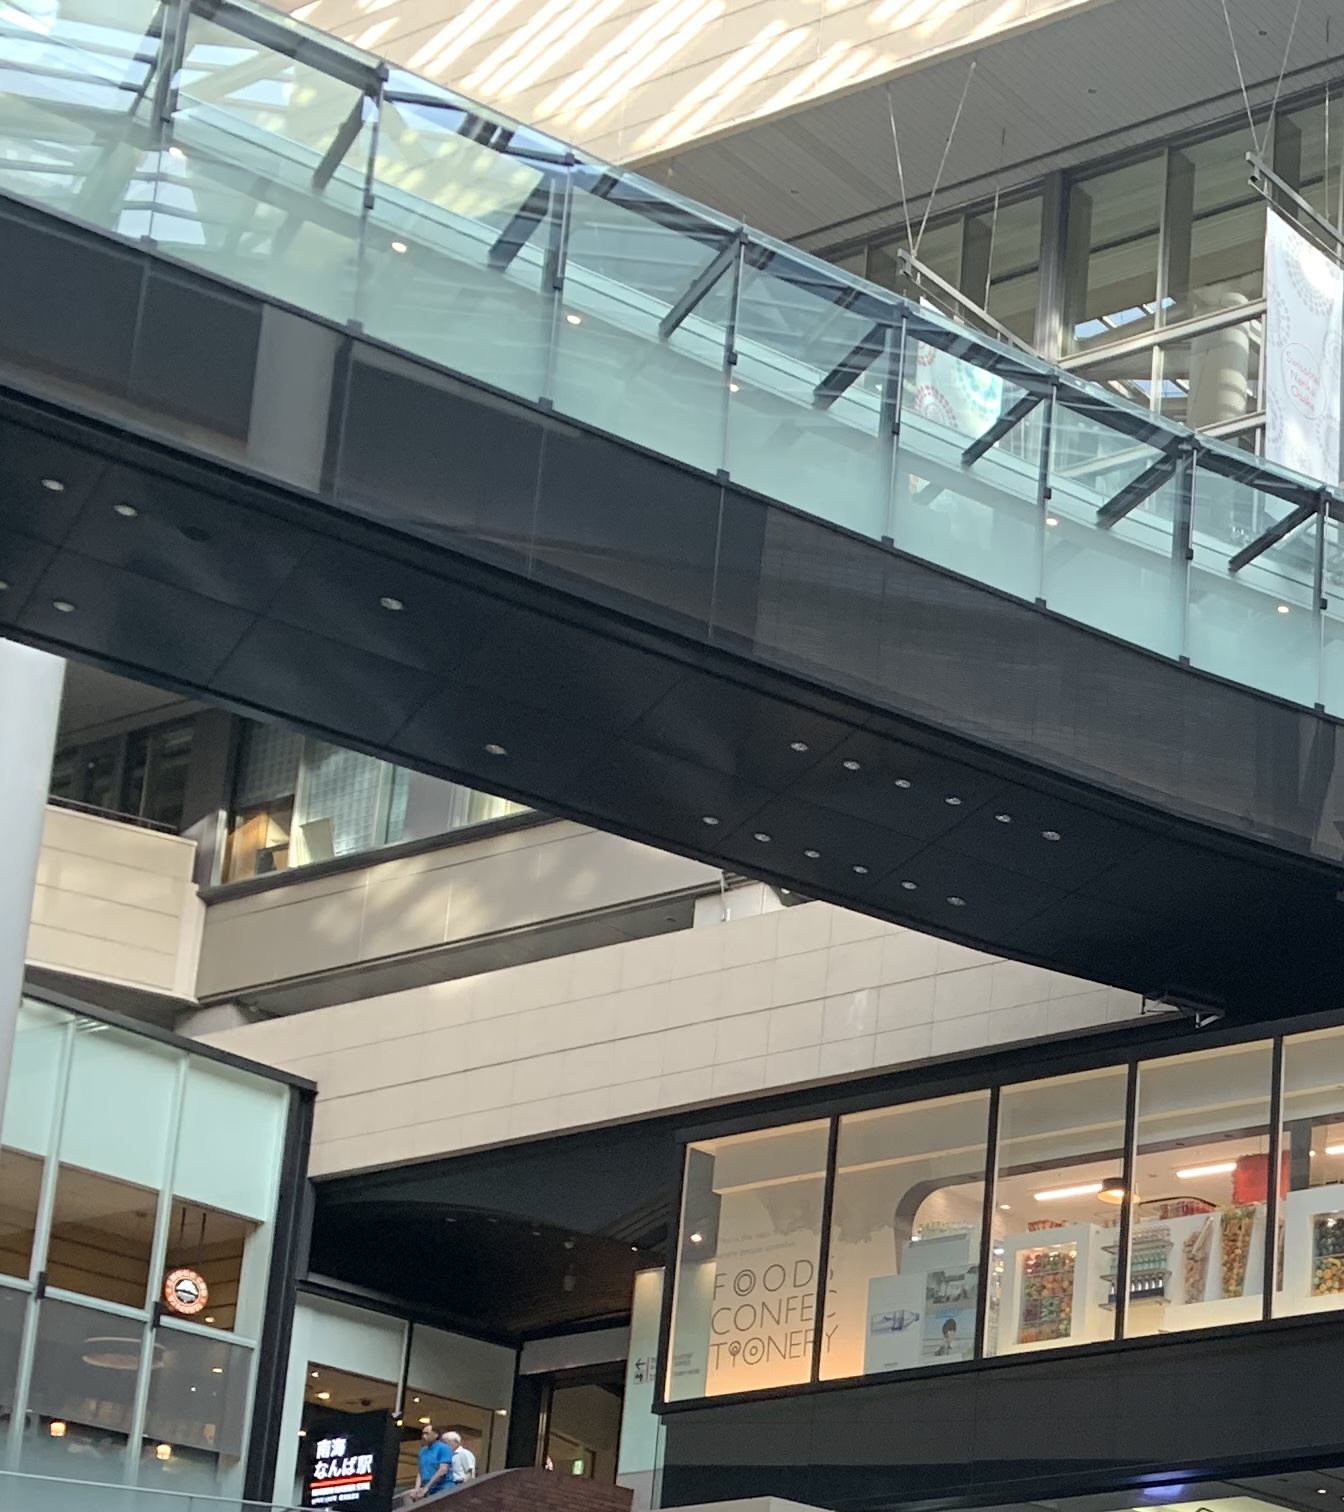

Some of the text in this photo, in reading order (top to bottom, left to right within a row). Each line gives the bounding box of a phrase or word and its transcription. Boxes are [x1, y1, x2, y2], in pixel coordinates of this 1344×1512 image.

[316, 1438, 347, 1459] 南海
[313, 1454, 374, 1480] なんば駅
